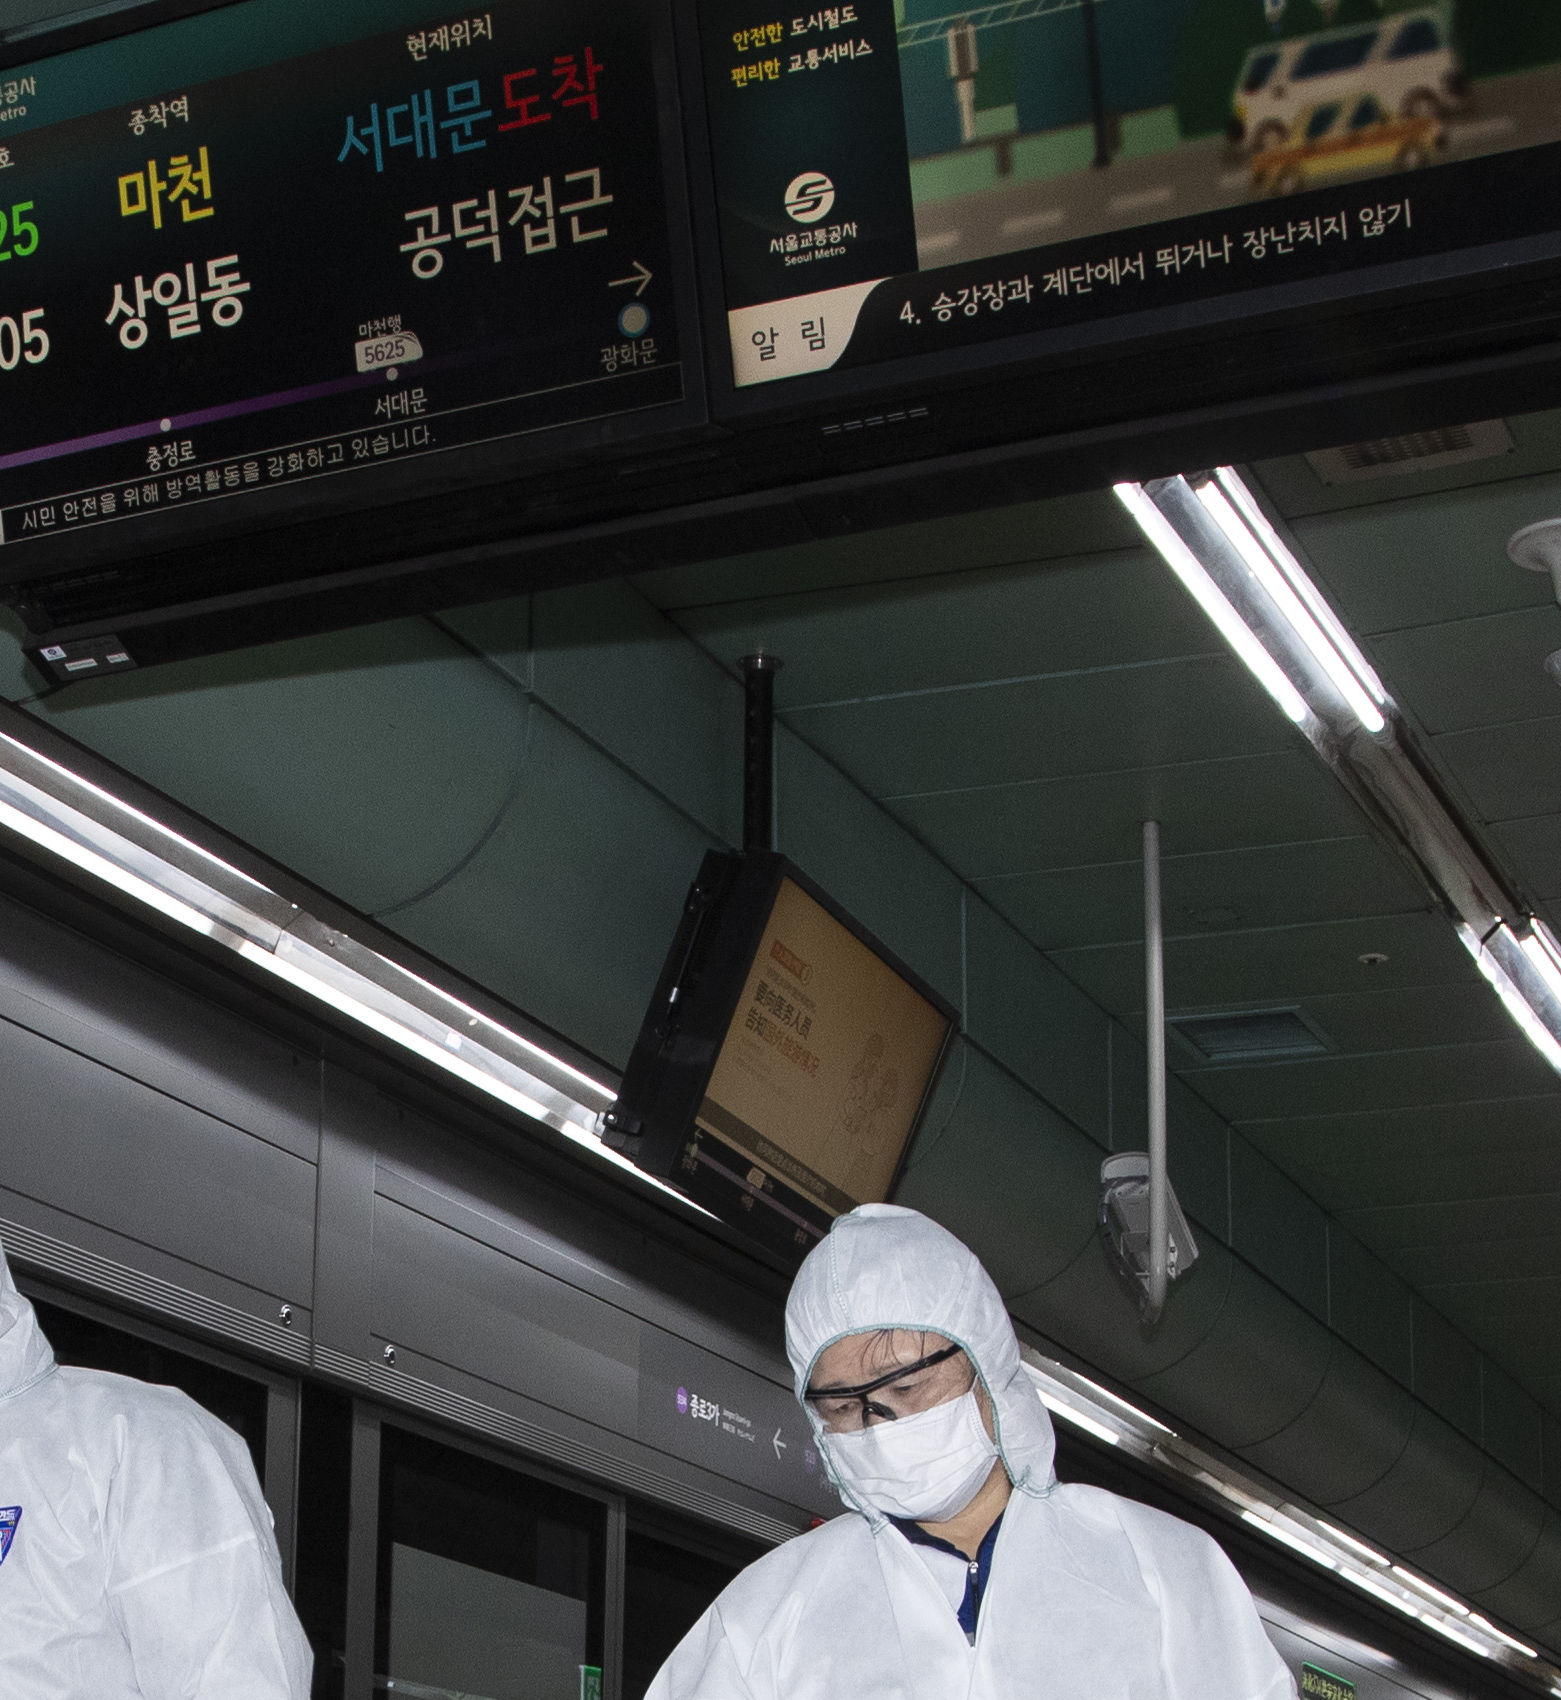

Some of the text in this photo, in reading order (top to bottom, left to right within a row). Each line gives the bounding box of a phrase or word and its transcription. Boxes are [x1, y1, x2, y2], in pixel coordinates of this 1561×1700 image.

[407, 14, 493, 61] 현재위치
[732, 4, 859, 52] 안전한 도시철도
[731, 38, 873, 87] 편리한 교통서비스
[129, 96, 189, 135] 종착역
[118, 146, 215, 229] 마천
[770, 221, 858, 254] 서울교통공사
[784, 245, 846, 267] Seoul Metro
[899, 198, 1412, 325] 4. 승강장과 계단에서 뛰거나 장난치지 않기
[105, 254, 251, 350] 상일동
[359, 313, 402, 338] 마천행
[364, 339, 406, 365] 5625
[601, 337, 658, 372] 광화문
[375, 388, 428, 420] 서대문
[146, 440, 196, 472] 충정로
[22, 425, 436, 531] 시민 안전을 위해 방역활동을 강화하고 있습니다.
